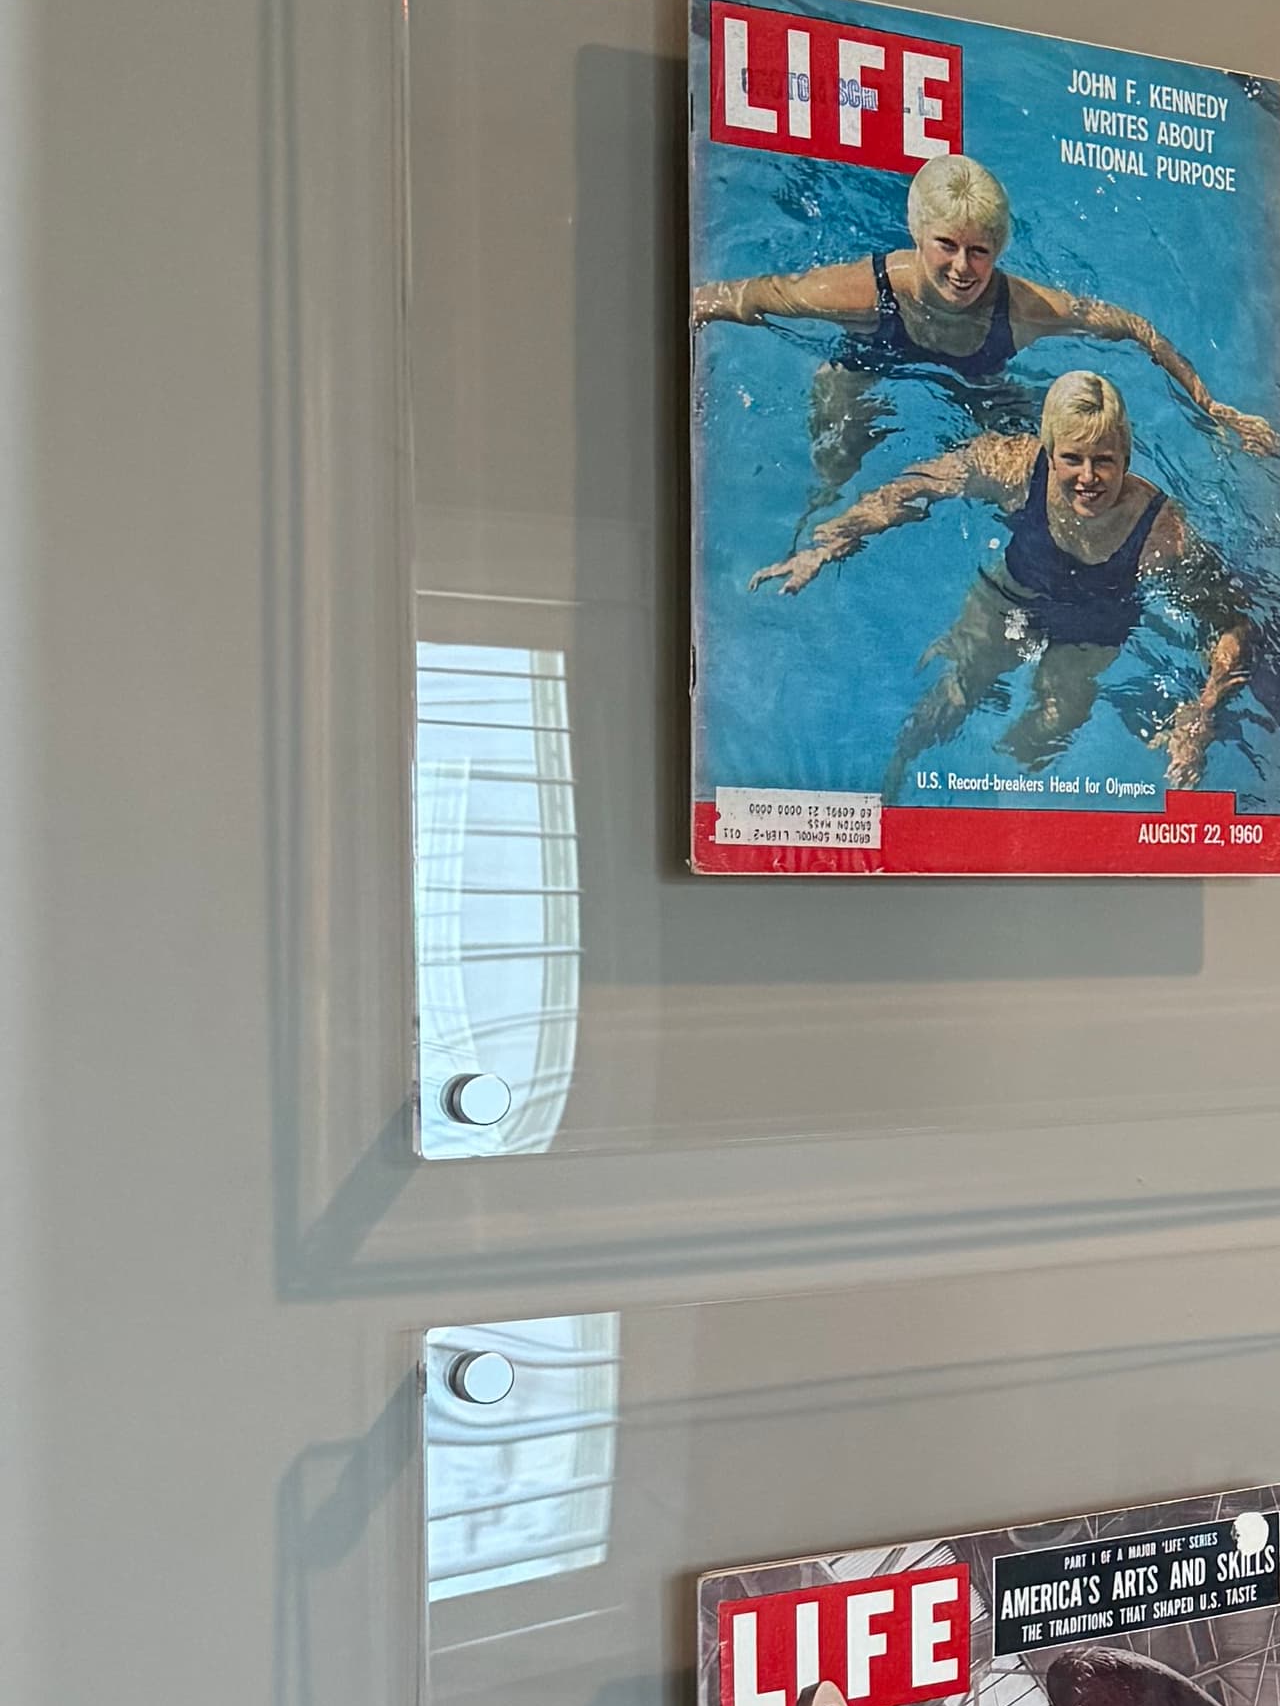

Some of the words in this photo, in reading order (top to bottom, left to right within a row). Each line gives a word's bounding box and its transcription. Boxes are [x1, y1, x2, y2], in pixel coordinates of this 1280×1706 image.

[724, 17, 950, 160] LIFE
[1068, 69, 1116, 101] JOHN
[1126, 79, 1141, 105] F.
[1150, 83, 1228, 122] KENNEDY
[1083, 107, 1148, 141] WRITES
[1157, 121, 1215, 154] ABOUT
[1061, 139, 1148, 177] NATIONAL
[1157, 155, 1236, 192] PURPOSE
[917, 771, 942, 790] U.S.
[948, 773, 1044, 793] Record-breakers
[1050, 776, 1079, 794] Head
[1085, 779, 1100, 794] for
[1105, 778, 1155, 798] Olympics
[1138, 824, 1197, 844] AUGUST
[1203, 824, 1225, 847] 22,
[1230, 825, 1263, 844] 1960
[1064, 1556, 1086, 1570] PART
[1101, 1549, 1112, 1564] OF
[1117, 1547, 1123, 1561] A
[1128, 1543, 1156, 1559] MAJOR
[1189, 1533, 1218, 1549] SERIES
[1001, 1576, 1100, 1620] AMERICA'S
[1112, 1565, 1158, 1601] ARTS
[1170, 1557, 1206, 1591] AND
[1217, 1545, 1275, 1582] SKILLS
[1022, 1624, 1042, 1643] THE
[1050, 1610, 1114, 1639] TRADITIONS
[1120, 1604, 1147, 1625] THAT
[1153, 1596, 1194, 1619] SHAPED
[1200, 1592, 1221, 1610] U.S.
[1226, 1584, 1257, 1605] TASTE
